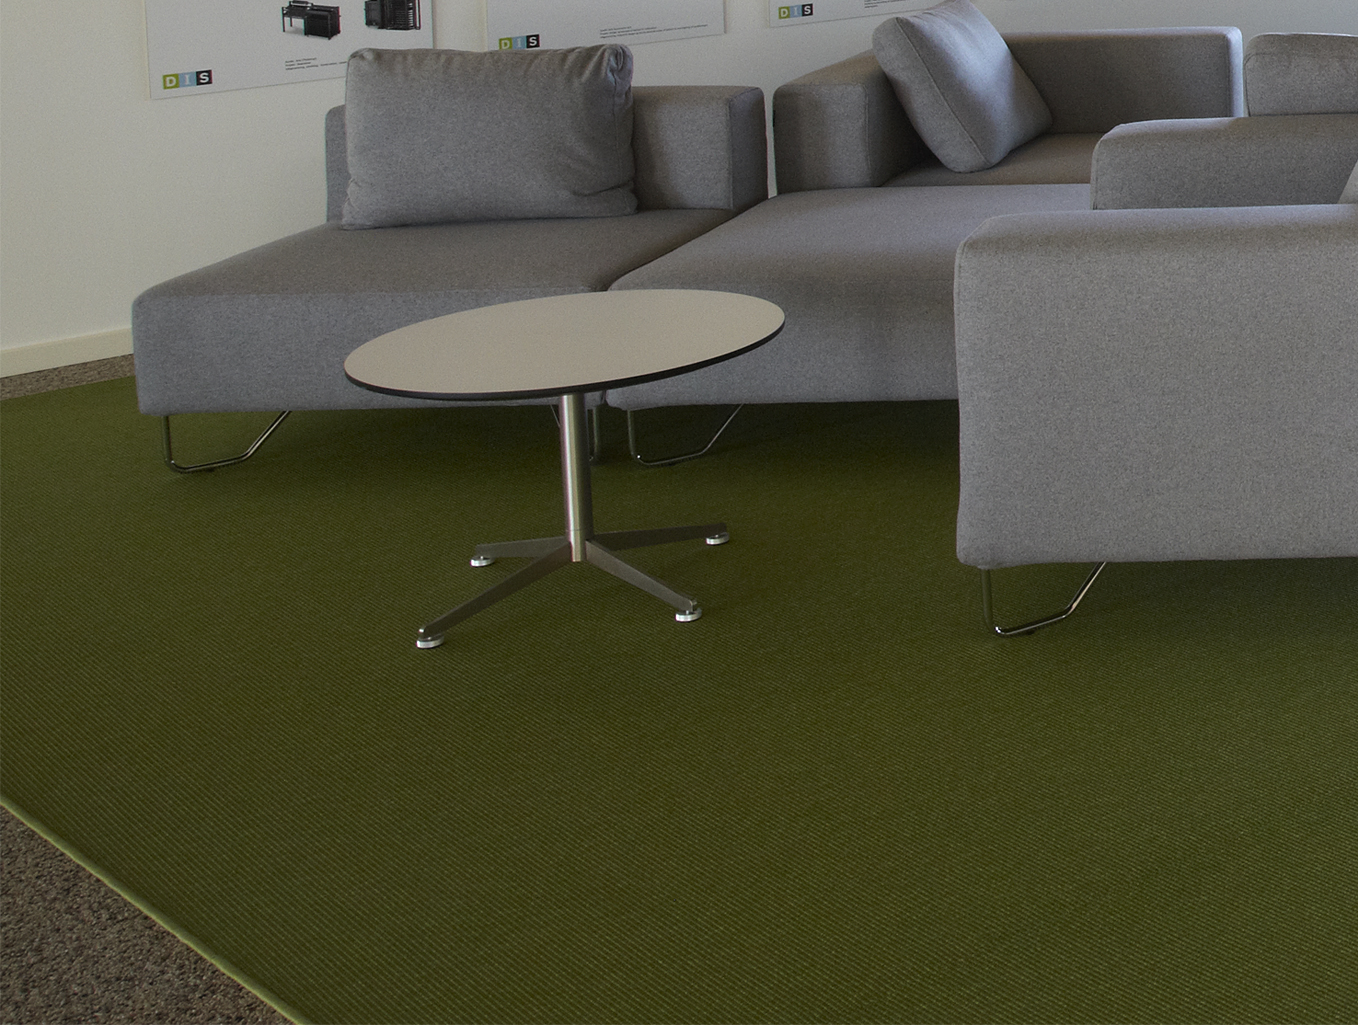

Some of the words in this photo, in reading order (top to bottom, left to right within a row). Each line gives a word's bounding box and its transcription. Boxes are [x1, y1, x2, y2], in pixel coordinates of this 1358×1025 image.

[780, 5, 812, 17] DIS
[500, 36, 538, 50] DIS
[165, 72, 210, 87] DIS
